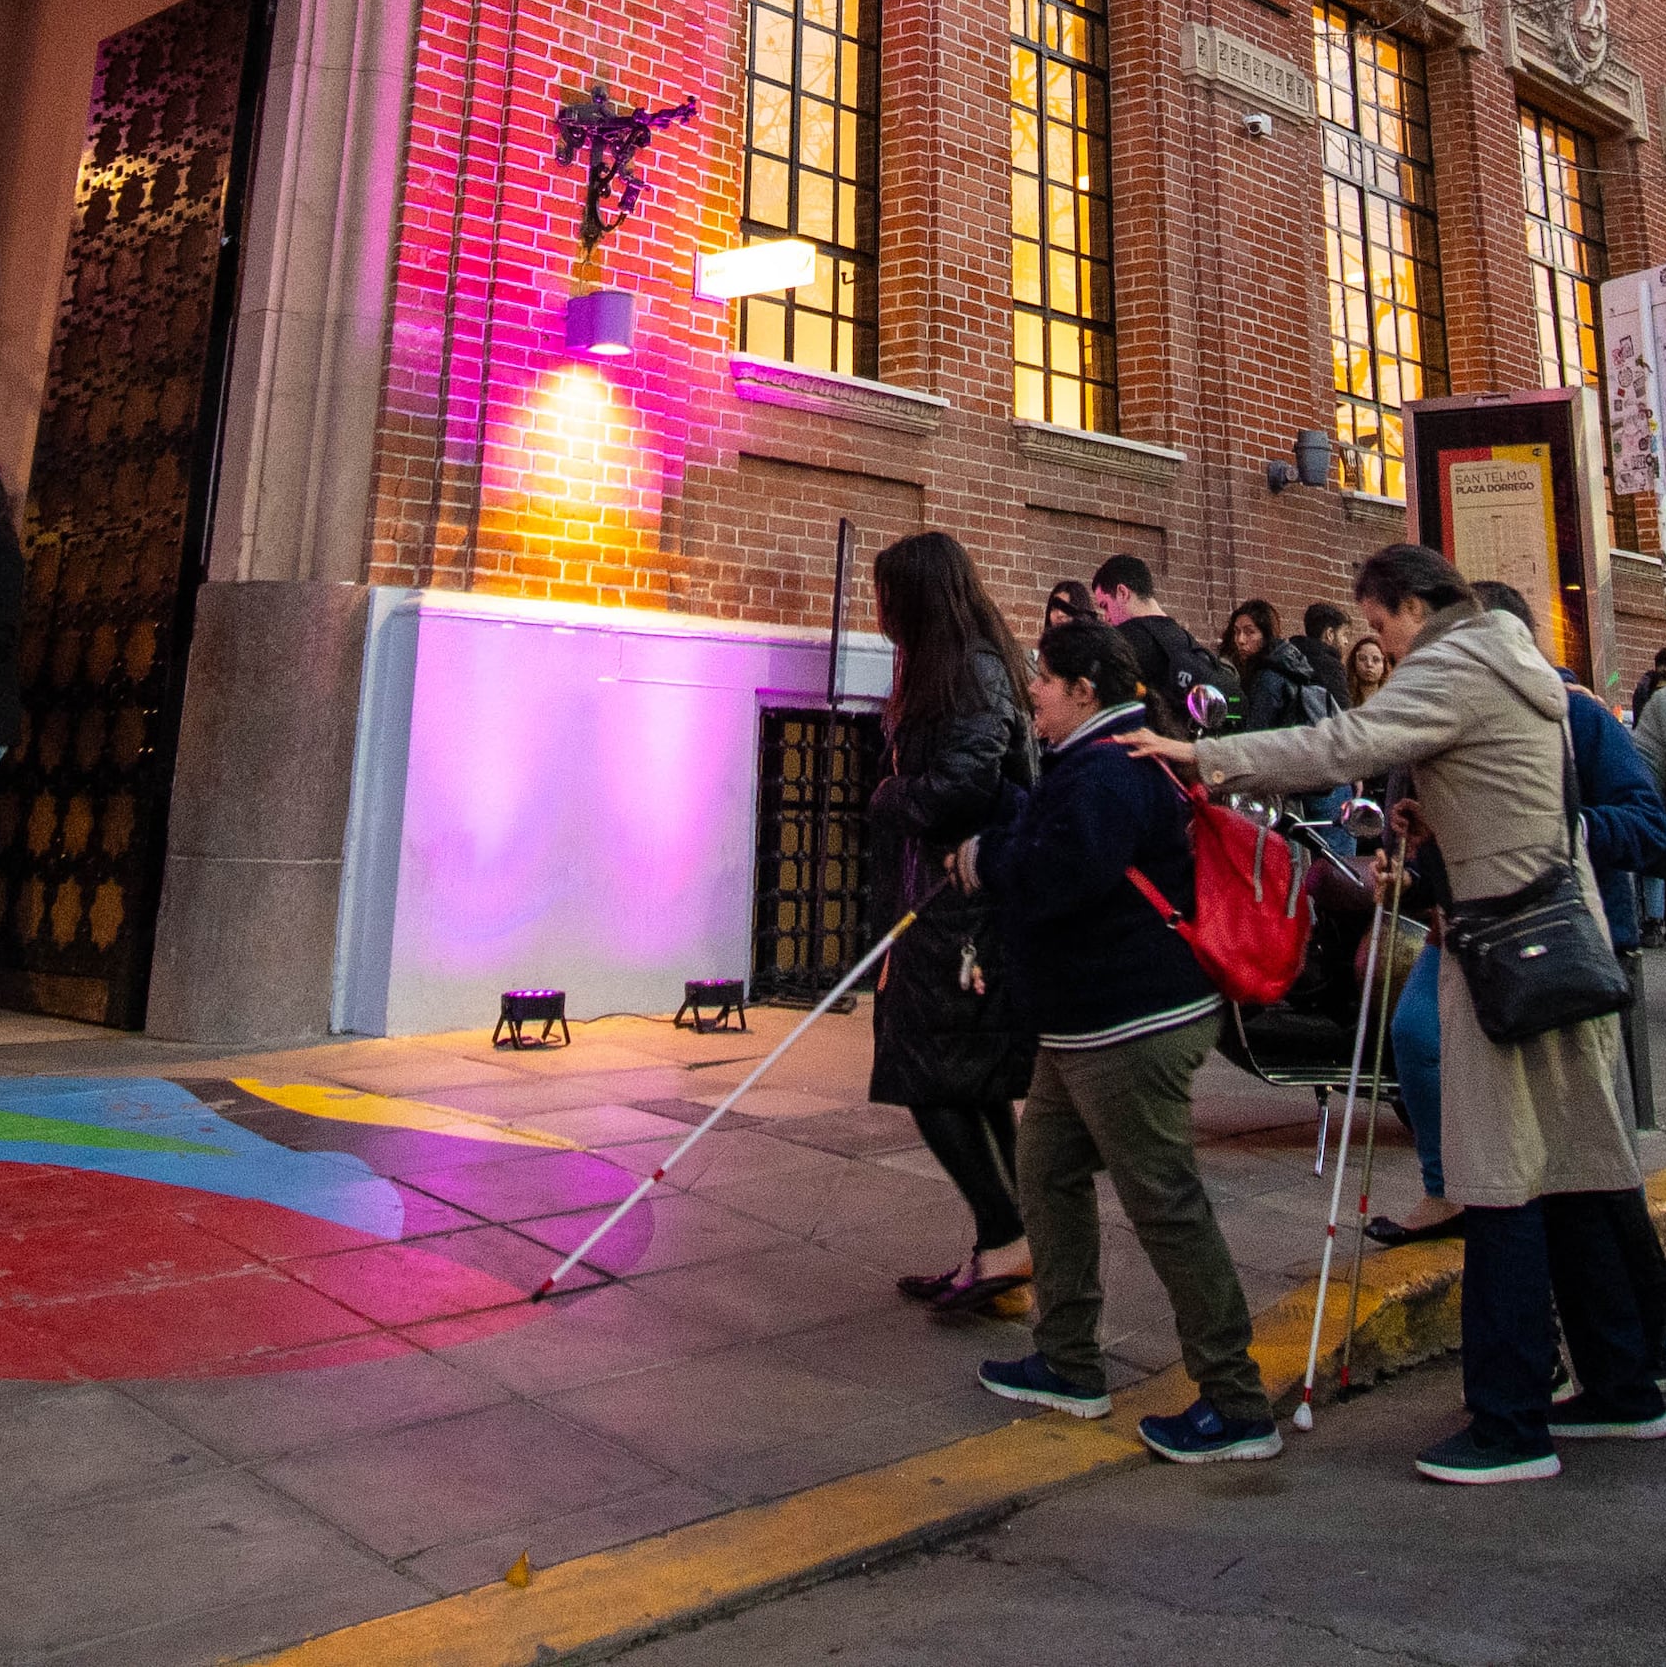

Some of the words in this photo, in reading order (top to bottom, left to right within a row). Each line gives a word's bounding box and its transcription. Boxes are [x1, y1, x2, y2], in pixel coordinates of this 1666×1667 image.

[1455, 473, 1480, 485] SAN
[1484, 470, 1527, 483] TELMO
[1456, 485, 1485, 495] PLAZA
[1487, 481, 1535, 492] DORREGO
